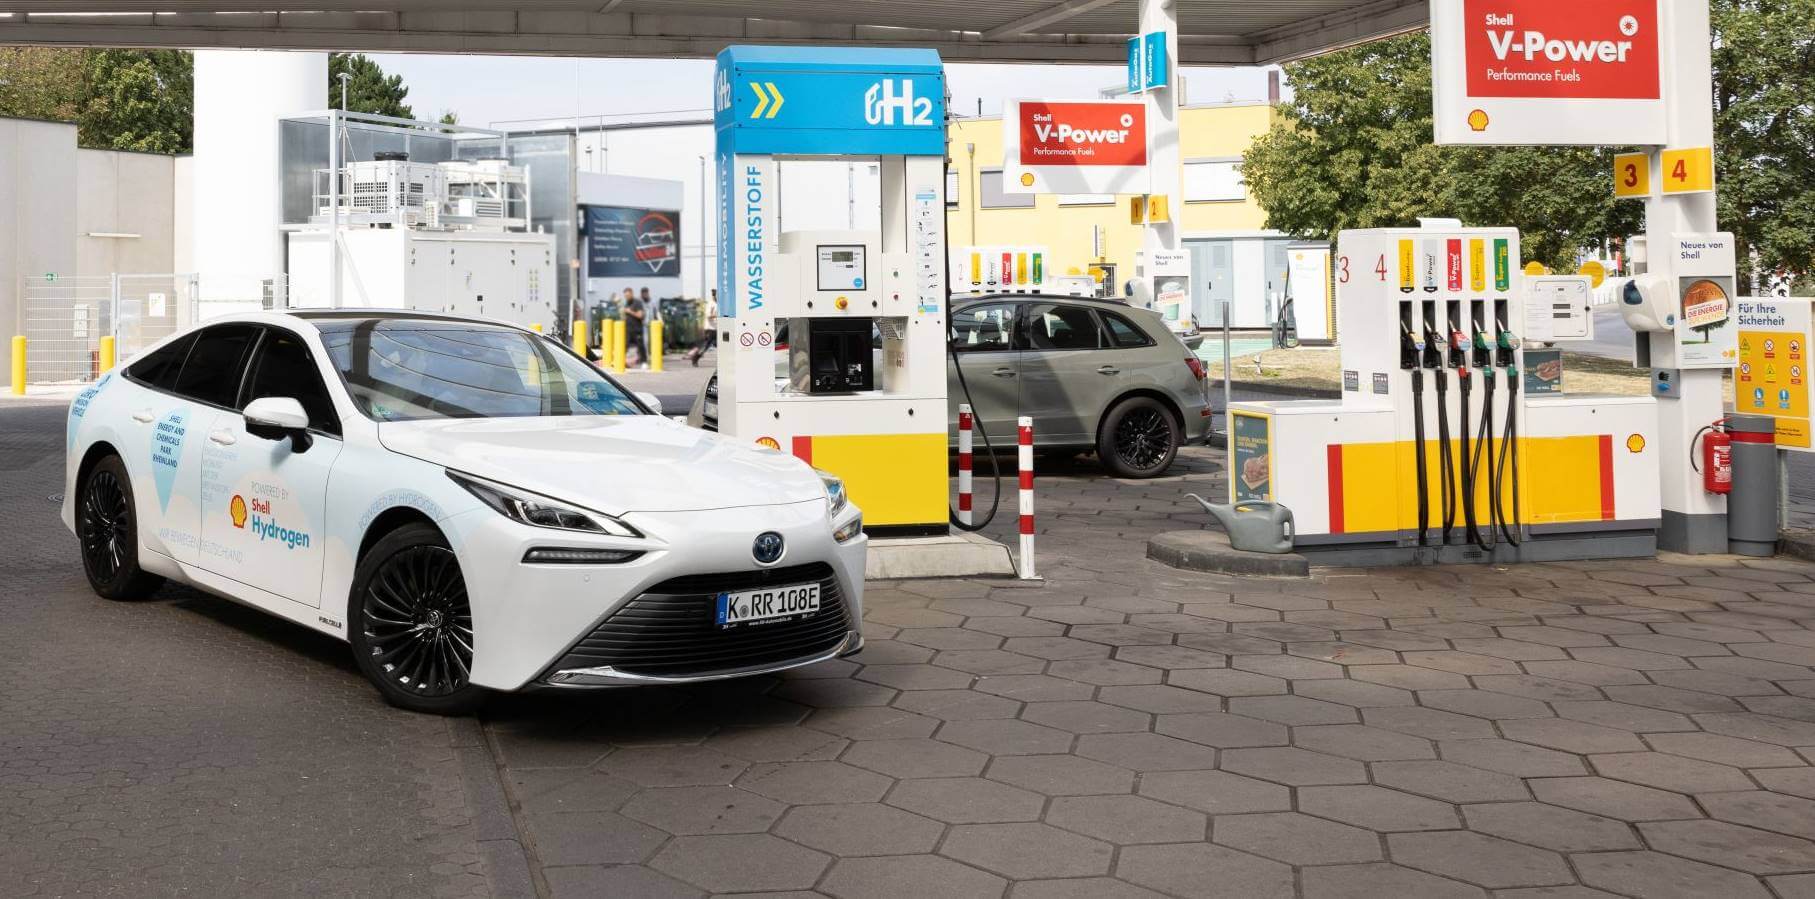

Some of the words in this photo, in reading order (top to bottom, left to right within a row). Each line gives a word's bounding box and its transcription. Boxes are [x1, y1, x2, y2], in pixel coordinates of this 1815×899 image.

[1486, 14, 1514, 26] Shell
[1487, 30, 1632, 63] V-Power
[1487, 69, 1552, 82] Performance
[1555, 70, 1581, 82] Fuels
[882, 79, 933, 126] H2
[1033, 114, 1052, 122] Shell
[1034, 124, 1129, 144] V-Power
[1033, 148, 1076, 156] Performance
[1078, 148, 1095, 156] Fuels
[1624, 163, 1638, 188] 3
[1671, 159, 1687, 182] 4
[1134, 203, 1139, 217] 1
[1151, 201, 1157, 216] 2
[746, 166, 763, 310] WASSERSTOFF
[1681, 241, 1706, 249] Neues
[1681, 251, 1700, 260] Shell
[1339, 256, 1350, 283] 3
[1375, 254, 1388, 281] 4
[1449, 253, 1457, 281] V-Power
[1738, 304, 1753, 313] Für
[1757, 304, 1776, 313] Ihre
[1738, 315, 1785, 325] Sicherheit
[157, 422, 174, 434] ENERGY
[174, 427, 185, 436] AND
[156, 433, 180, 446] CHEMICALS
[160, 445, 172, 455] PARK
[251, 481, 279, 498] POWERED
[281, 488, 289, 500] BY
[252, 498, 270, 515] Shell
[252, 514, 309, 549] Hydrogen
[728, 596, 739, 619] K
[751, 593, 773, 616] RR
[777, 587, 819, 613] 108E
